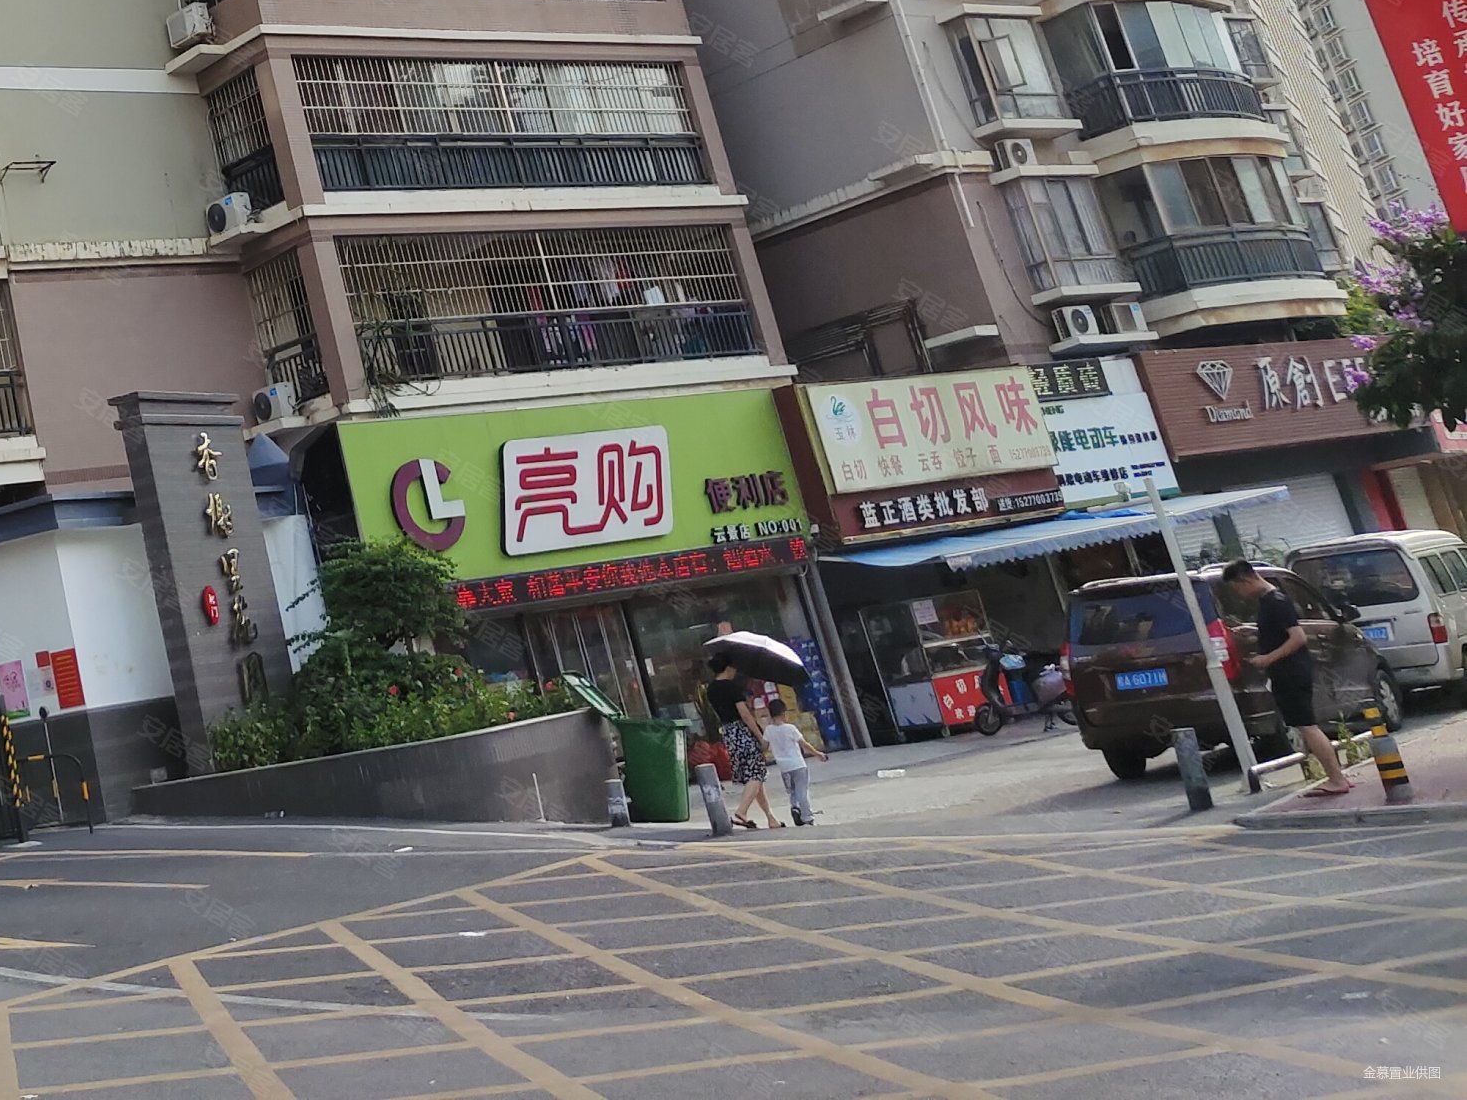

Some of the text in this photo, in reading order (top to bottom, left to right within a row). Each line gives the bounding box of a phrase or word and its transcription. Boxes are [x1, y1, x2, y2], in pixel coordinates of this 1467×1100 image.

[1411, 37, 1467, 195] 培育好家
[865, 375, 1039, 450] 白切风味
[1205, 400, 1253, 423] Diamond
[835, 426, 857, 441] 玉林
[841, 459, 868, 482] 白切
[878, 454, 904, 477] 快餐
[918, 451, 943, 473] 云吞
[953, 447, 977, 469] 饺子
[987, 444, 1002, 464] 面
[515, 440, 664, 543] 亮购
[705, 470, 790, 514] 便利店
[859, 486, 989, 529] 蓝正酒类批发部
[712, 522, 751, 544] 云景店
